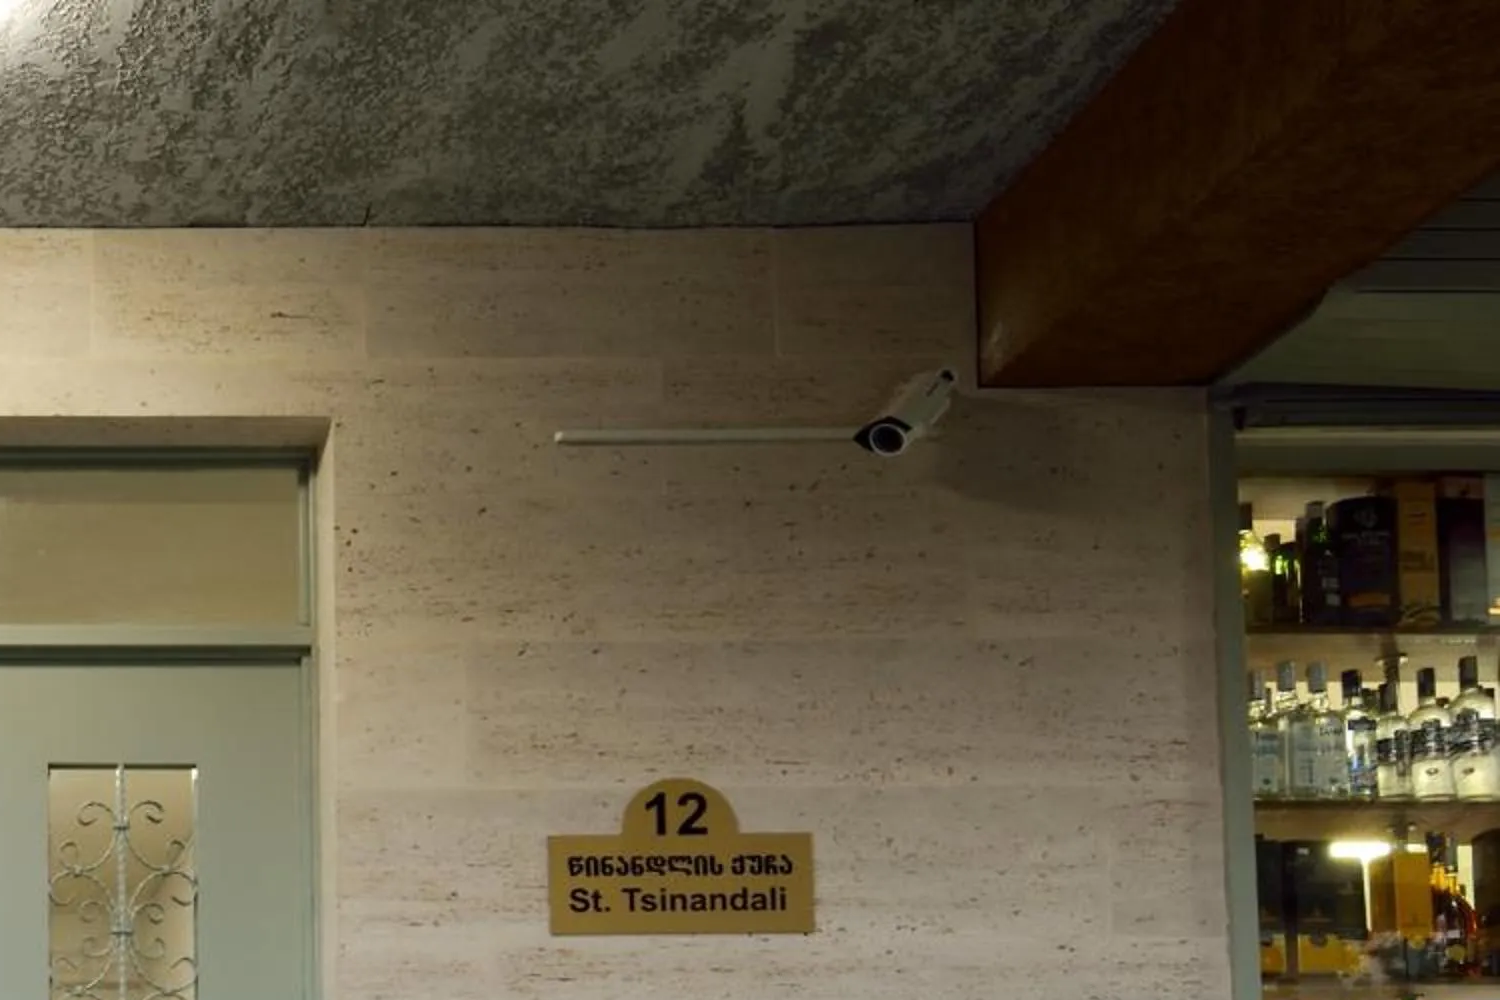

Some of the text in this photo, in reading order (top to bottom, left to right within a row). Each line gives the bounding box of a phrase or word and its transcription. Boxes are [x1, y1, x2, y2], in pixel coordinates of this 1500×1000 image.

[645, 791, 708, 836] 12
[567, 855, 794, 877] წინანდლის ქუჩა
[569, 887, 788, 913] St. Tsinandali
